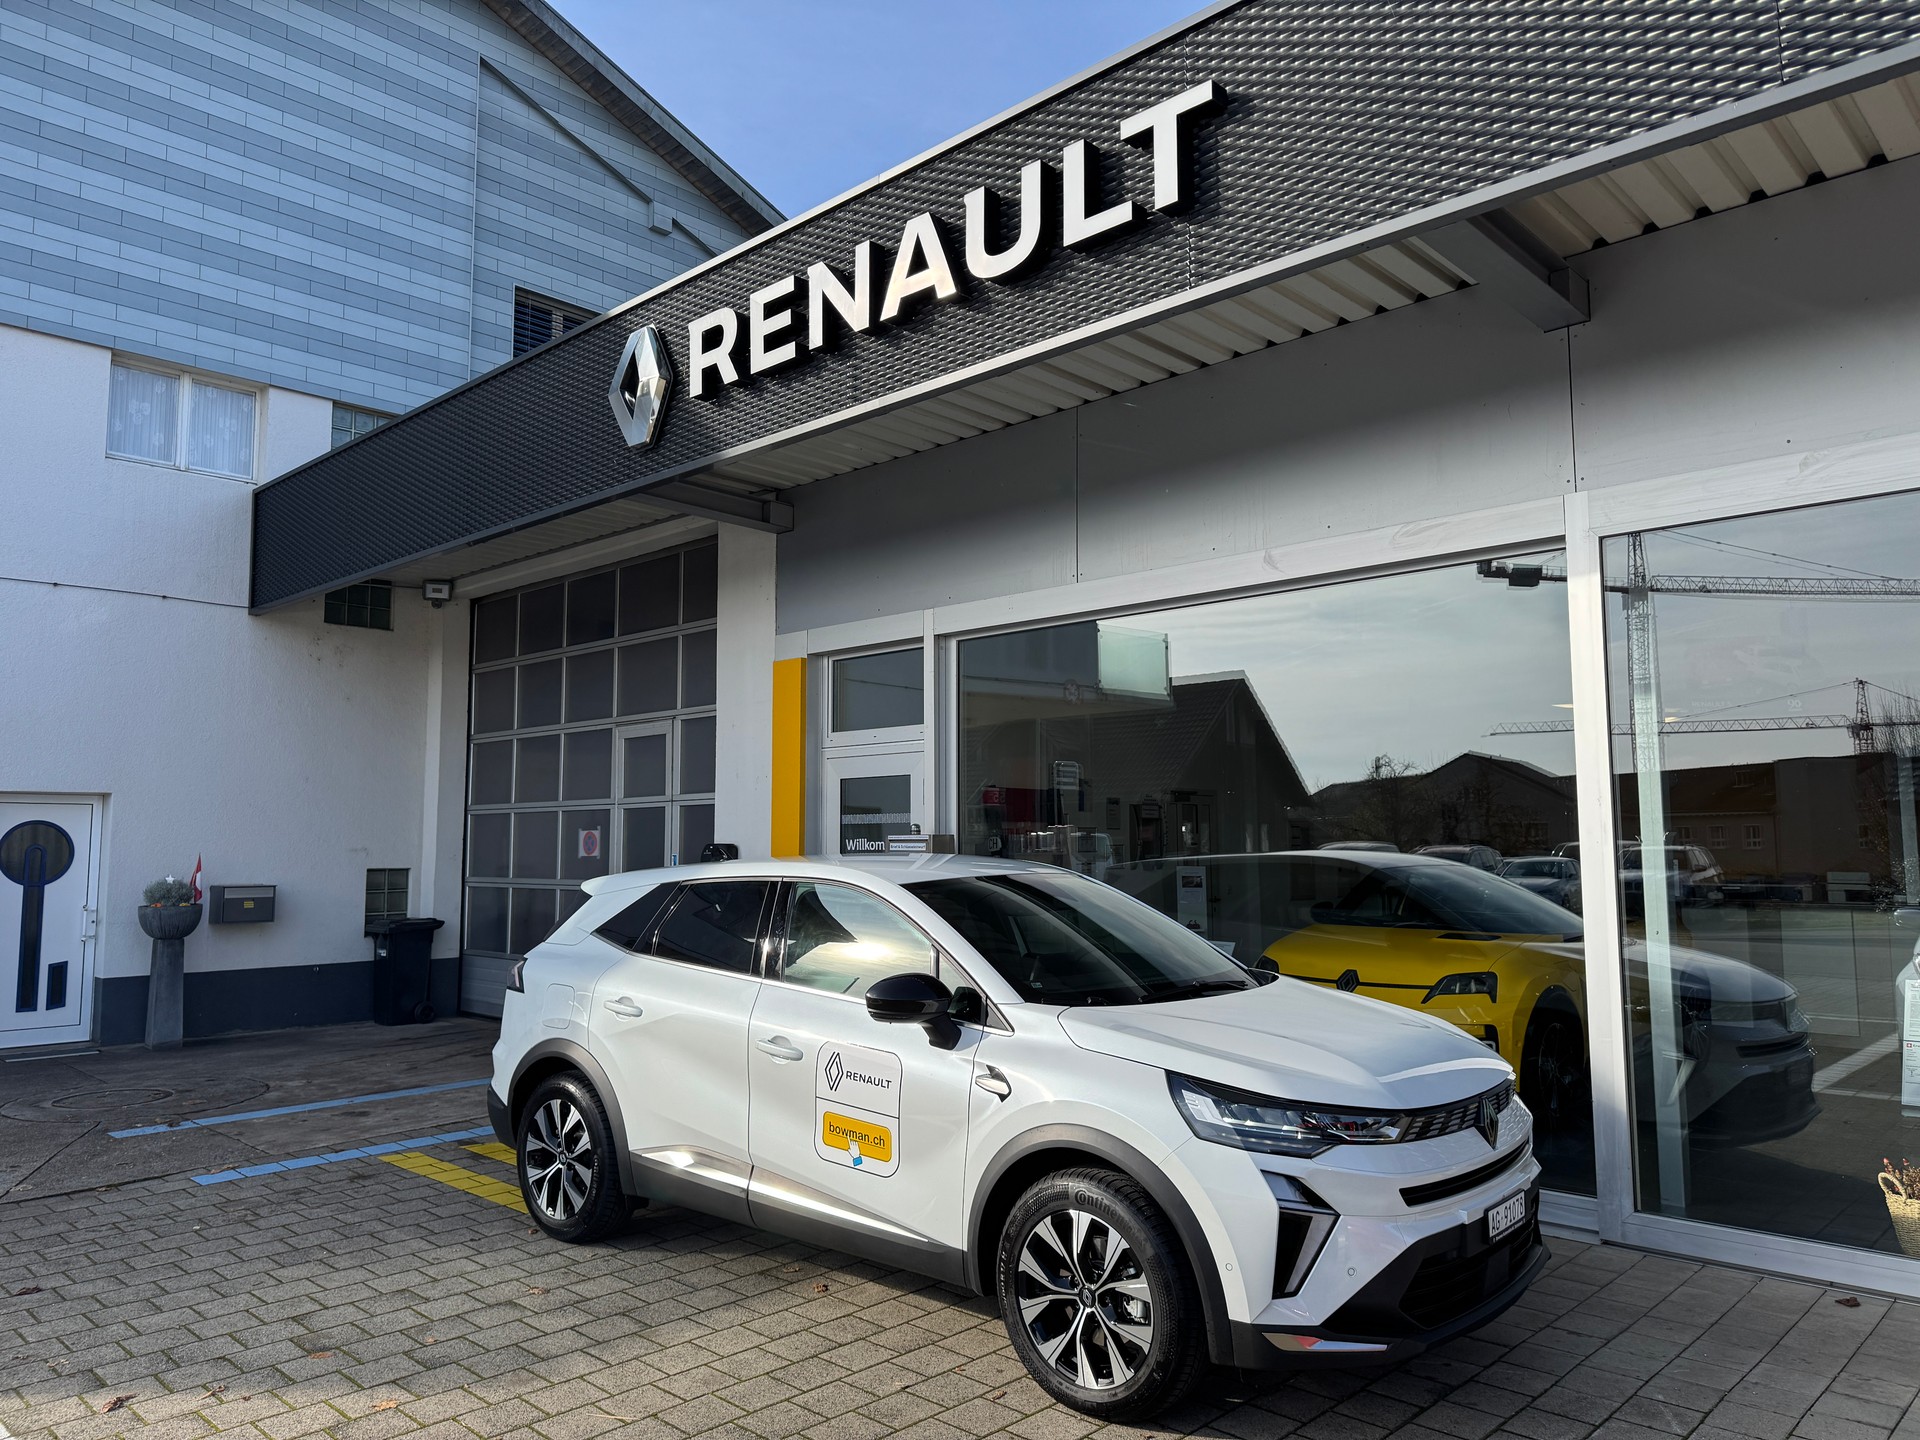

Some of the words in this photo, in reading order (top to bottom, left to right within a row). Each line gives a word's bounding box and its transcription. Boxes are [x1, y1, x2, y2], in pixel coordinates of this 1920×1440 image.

[688, 79, 1215, 400] RENAULT
[845, 838, 885, 851] Willkom
[989, 838, 998, 850] CH
[845, 1070, 892, 1089] RENAULT
[828, 1121, 886, 1147] bowman.ch
